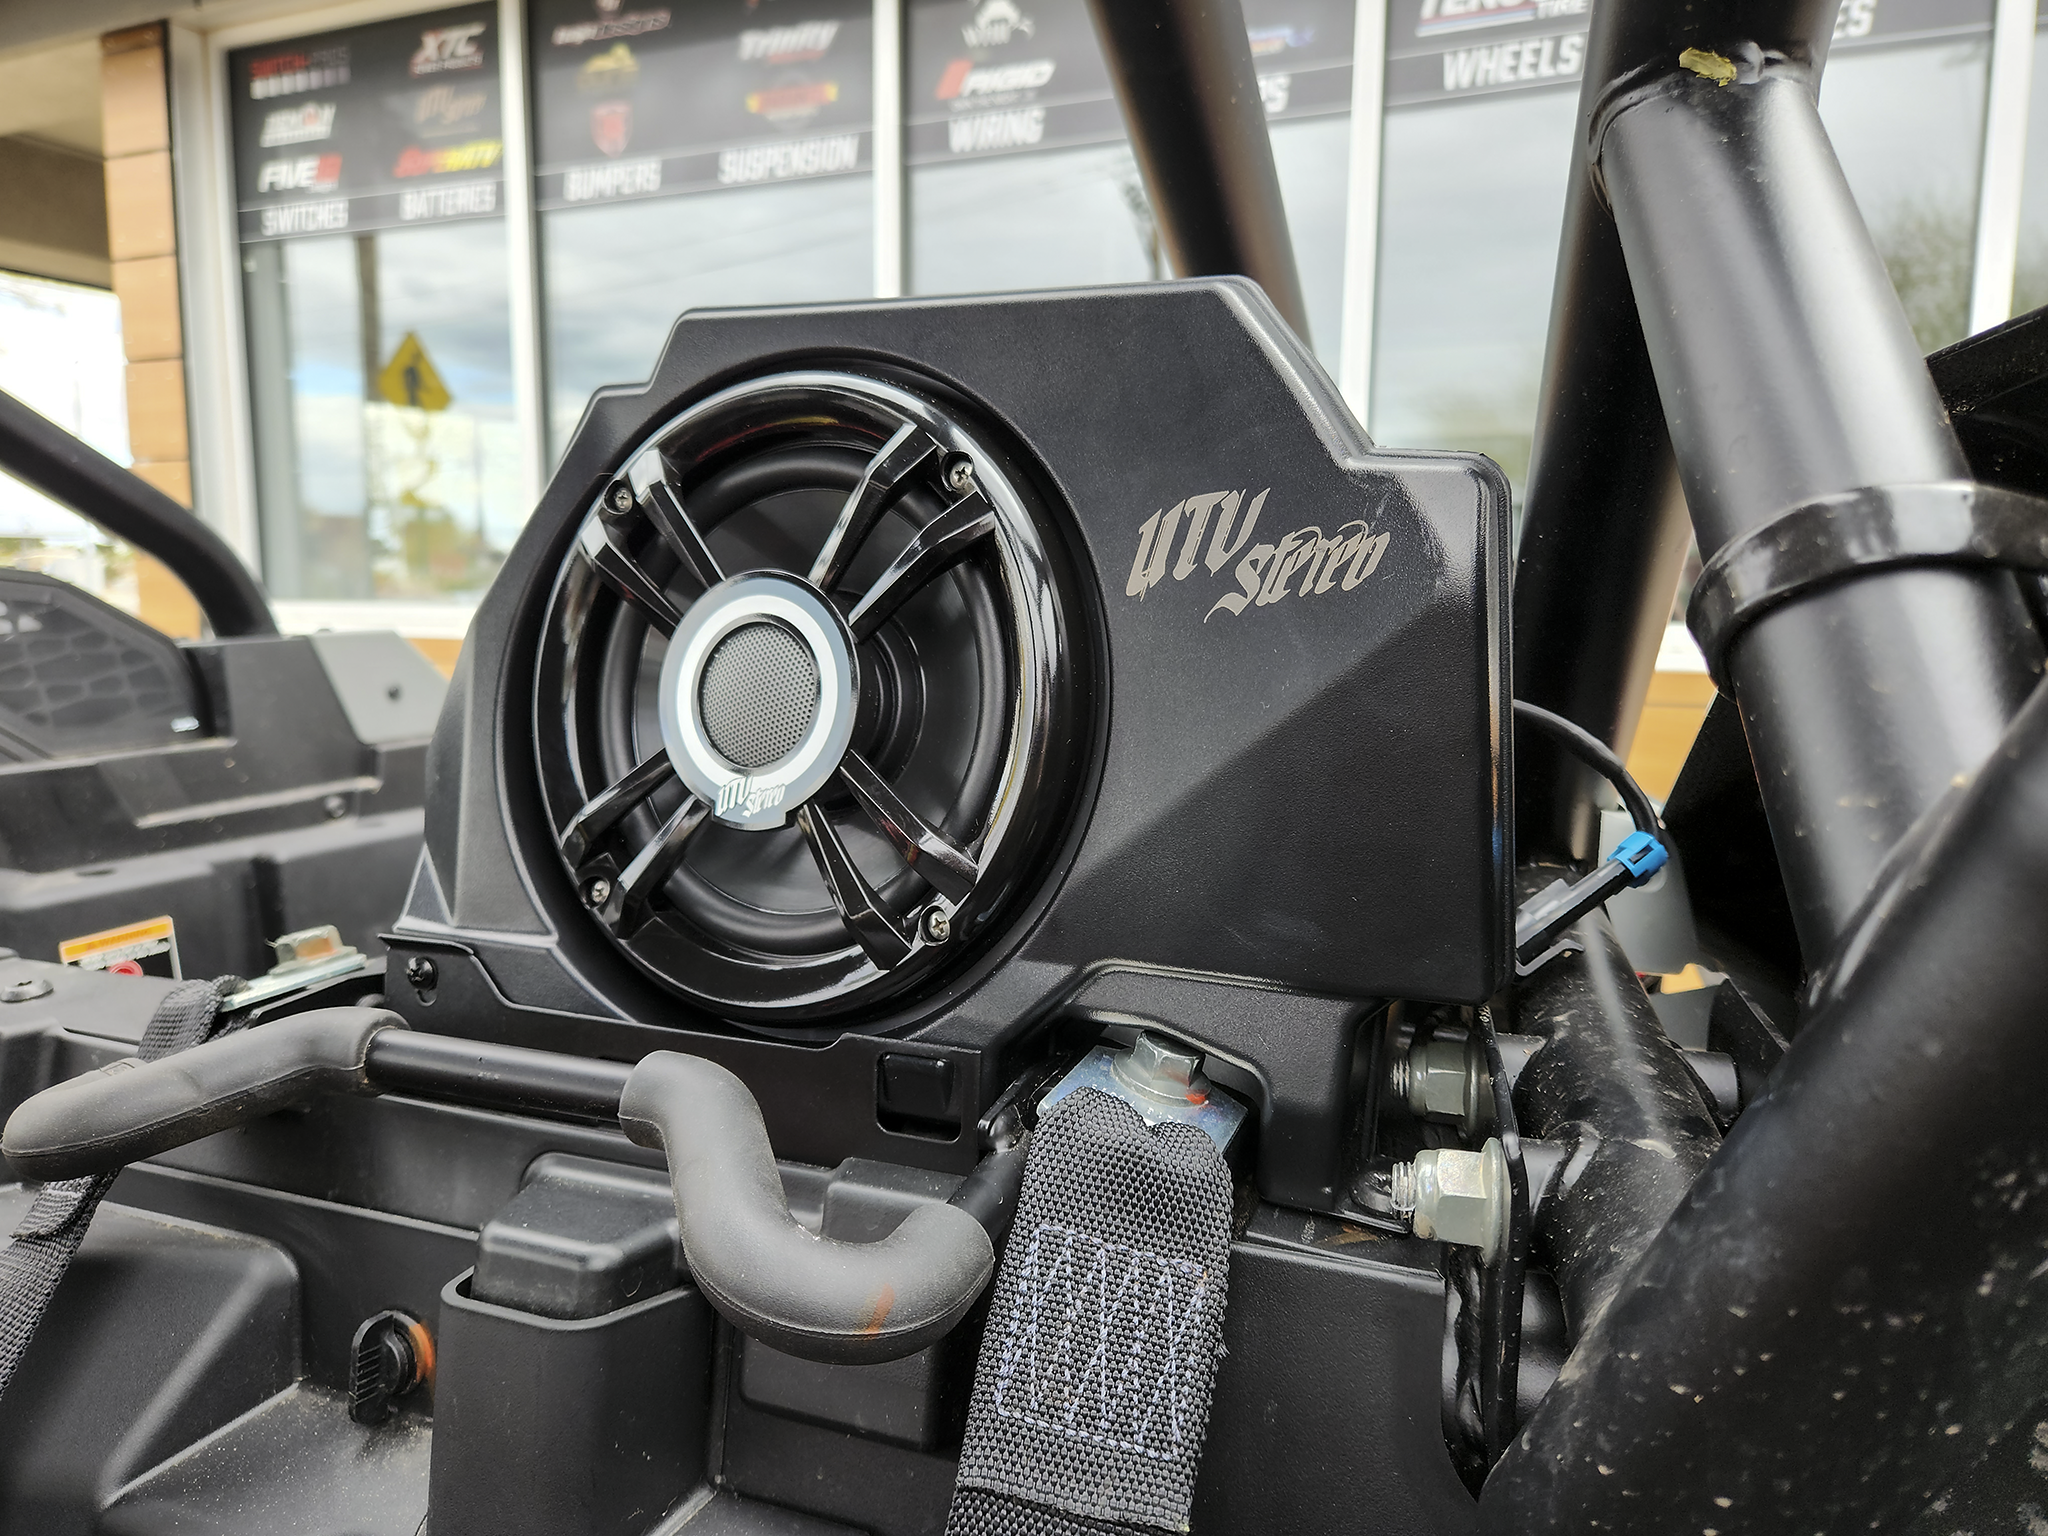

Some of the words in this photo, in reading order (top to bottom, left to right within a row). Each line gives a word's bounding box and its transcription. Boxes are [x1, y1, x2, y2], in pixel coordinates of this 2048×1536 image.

[411, 22, 488, 63] XTC
[1443, 34, 1584, 91] WHEELS
[947, 107, 1045, 153] WIRING
[718, 134, 857, 184] SUSPENSION
[401, 182, 496, 220] BATTERIES
[563, 160, 662, 201] BUMPERS
[261, 200, 349, 236] SWITCHES
[1126, 487, 1271, 602] UTV
[715, 776, 753, 816] UTV
